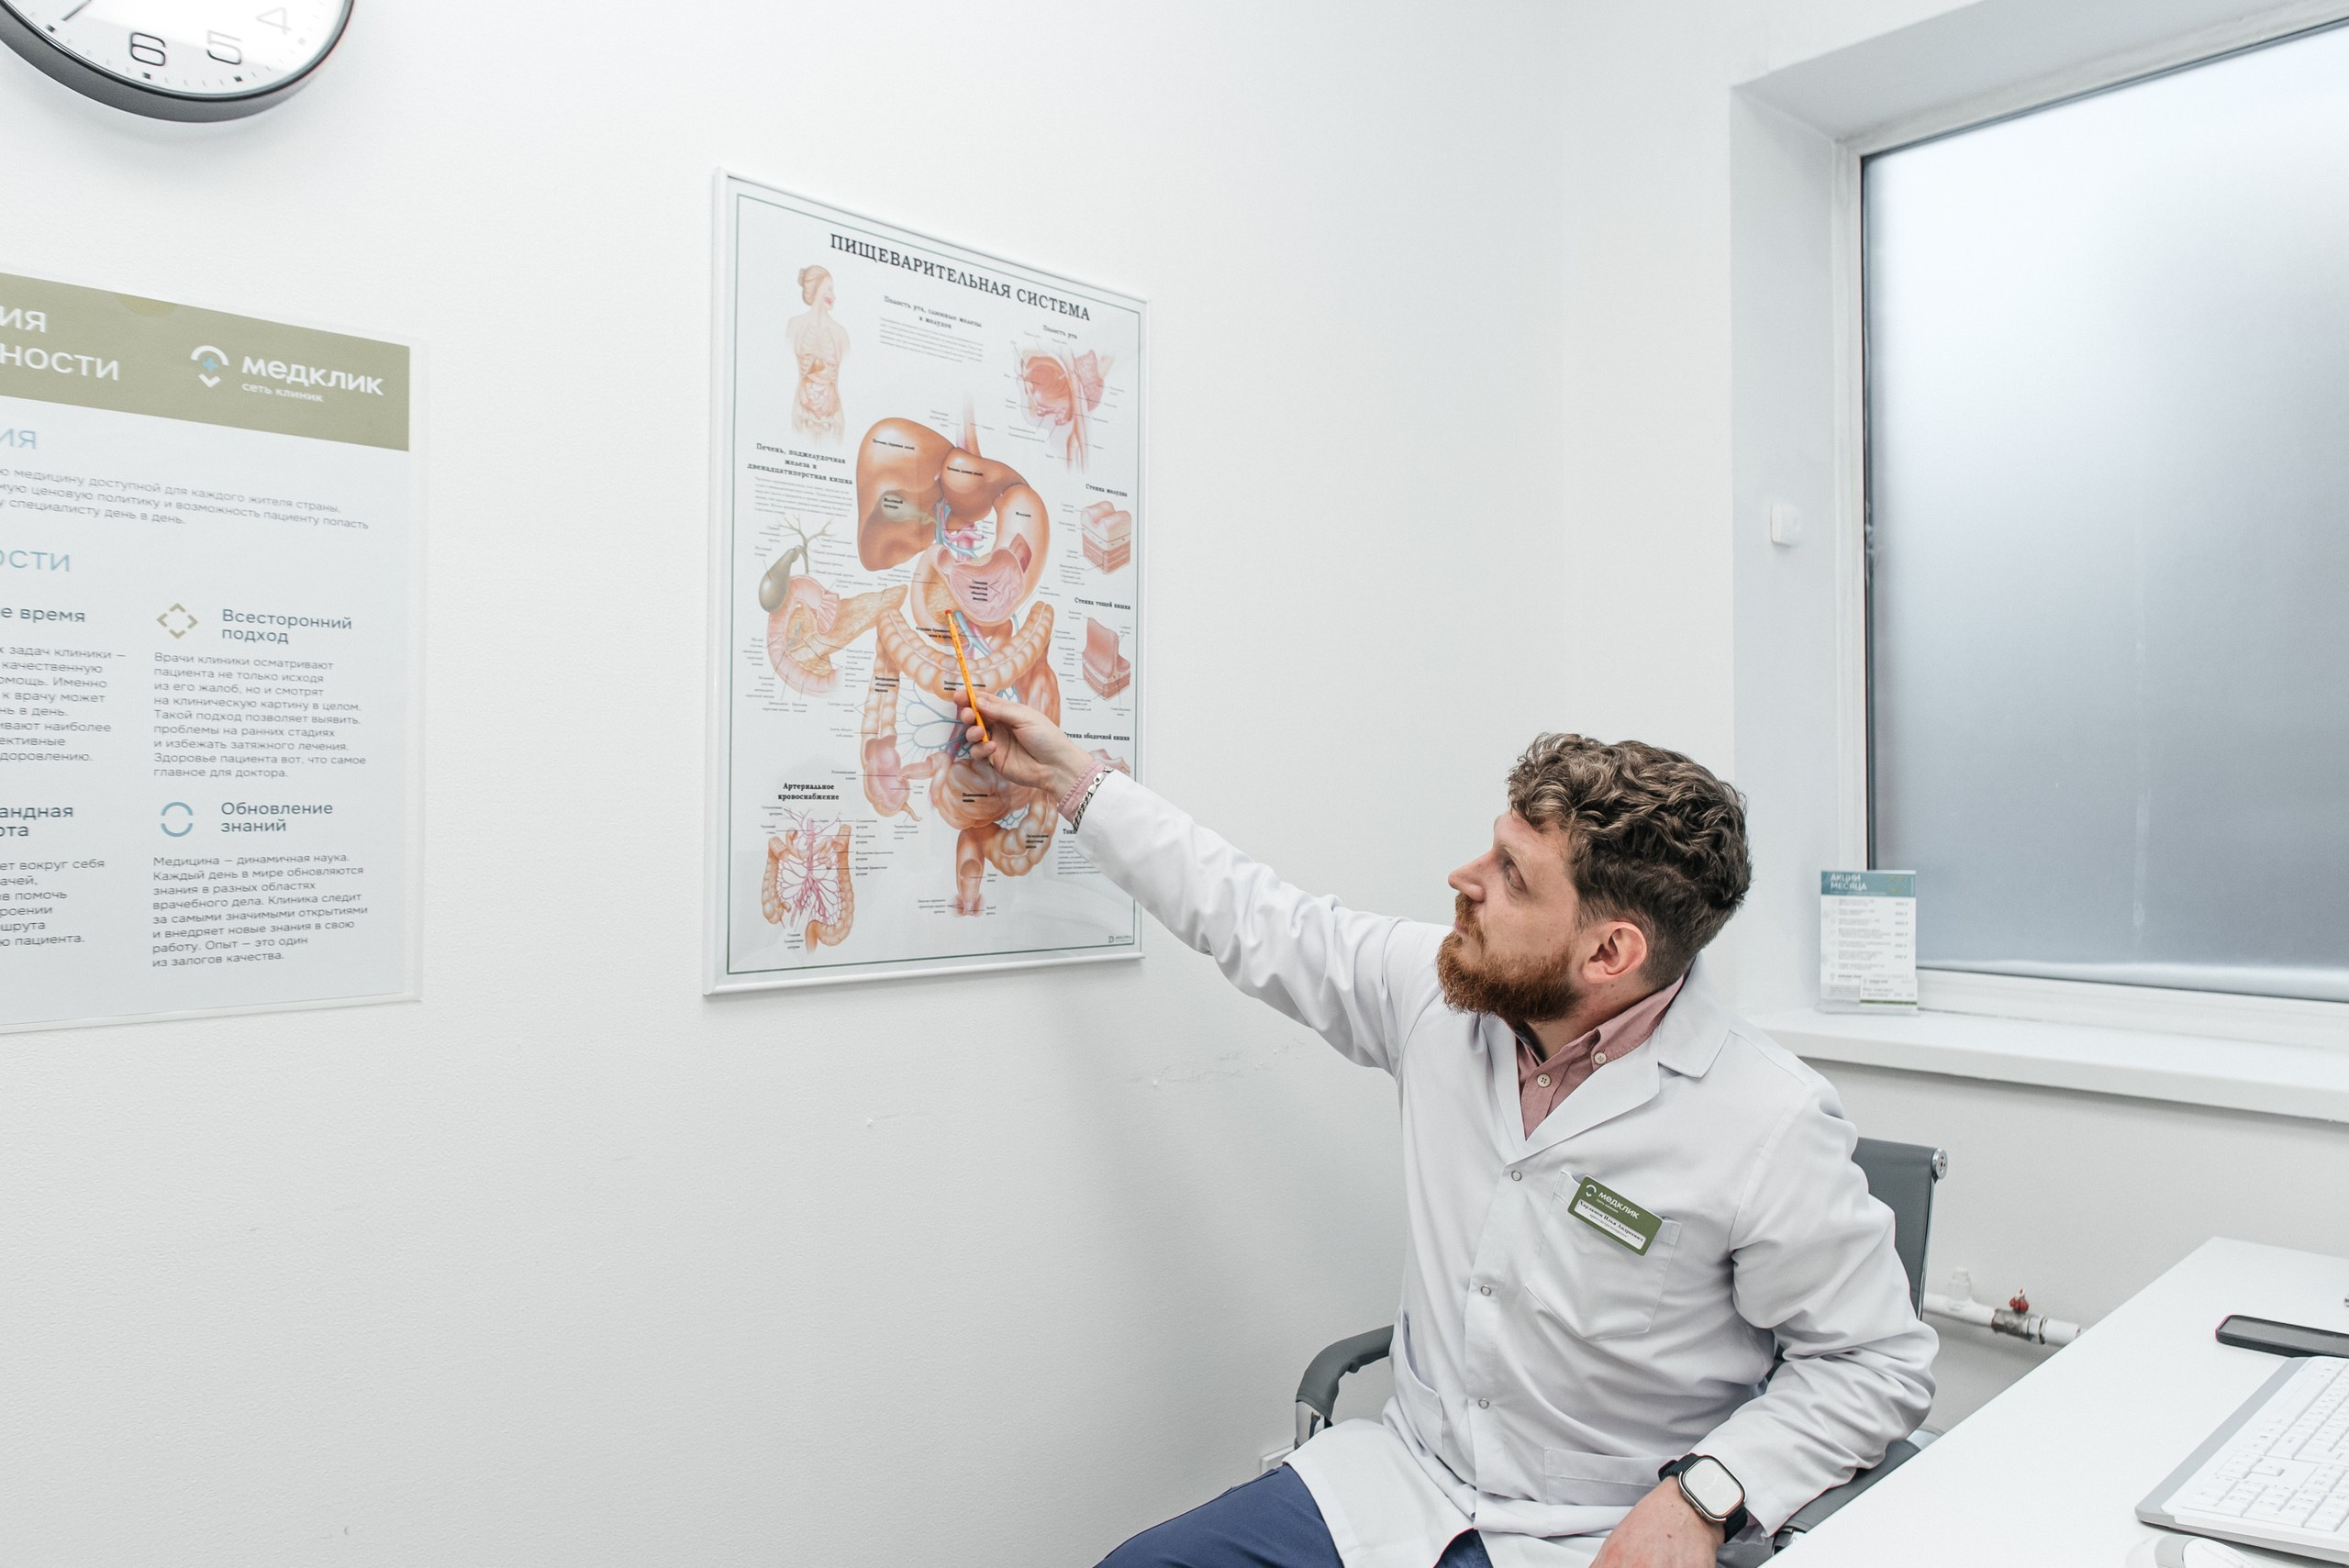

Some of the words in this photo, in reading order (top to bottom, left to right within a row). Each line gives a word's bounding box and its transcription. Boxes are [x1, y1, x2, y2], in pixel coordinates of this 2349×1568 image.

[130, 31, 166, 66] 6
[206, 29, 241, 65] 5
[829, 233, 1011, 299] ПИЩЕВАРИТЕЛЬНАЯ
[1017, 289, 1091, 321] СИСТЕМА
[0, 343, 119, 381] НОСТИ
[242, 356, 384, 395] медклик
[242, 383, 273, 395] сеть
[276, 388, 324, 402] клиник
[14, 470, 83, 485] медицину
[89, 478, 161, 493] доступной
[165, 486, 187, 495] для
[192, 489, 245, 503] каждого
[249, 495, 293, 506] жителя
[9, 499, 100, 517] специалисту
[105, 508, 137, 519] день
[151, 514, 185, 524] день.
[31, 487, 92, 501] ценовую
[97, 494, 160, 508] политику
[176, 502, 260, 518] возможность
[263, 512, 319, 526] пациенту
[323, 517, 369, 529] попасть
[0, 550, 70, 572] СТИ
[1, 607, 13, 617] е
[20, 608, 85, 623] время
[223, 609, 352, 629] Всесторонний
[222, 629, 289, 644] подход
[9, 646, 50, 657] задач
[54, 650, 112, 659] клиники
[2, 662, 103, 674] качественную
[154, 652, 194, 663] Врачи
[197, 656, 250, 666] клиники
[253, 658, 334, 670] осматривают
[53, 677, 107, 688] Именно
[154, 668, 214, 679] пациента
[218, 671, 233, 679] не
[237, 672, 279, 681] только
[282, 673, 324, 683] исходя
[154, 683, 170, 691] из
[173, 684, 195, 692] его
[275, 687, 324, 696] смотрят
[15, 693, 55, 704] врачу
[173, 698, 257, 709] клиническую
[261, 701, 308, 711] картину
[322, 703, 362, 712] целом.
[31, 708, 68, 717] день.
[154, 709, 193, 719] Такой
[196, 712, 242, 722] подход
[246, 713, 307, 723] позволяет
[45, 722, 111, 732] наиболее
[154, 726, 219, 736] проблемы
[241, 728, 284, 737] ранних
[288, 729, 335, 738] стадиях
[165, 740, 226, 749] избежать
[230, 741, 295, 751] затяжного
[297, 742, 349, 751] лечения.
[154, 753, 216, 763] Здоровье
[220, 755, 277, 764] пациента
[154, 768, 206, 777] главное
[209, 769, 231, 778] для
[235, 769, 288, 778] доктора.
[0, 807, 73, 820] андная
[221, 802, 334, 815] Обновление
[221, 818, 286, 832] знаний
[19, 861, 68, 872] вокруг
[72, 859, 105, 868] себя
[153, 856, 219, 867] Медицина
[237, 853, 310, 865] динамичная
[314, 853, 350, 863] наука.
[153, 871, 205, 882] Каждый
[208, 871, 238, 880] день
[252, 869, 284, 879] мире
[287, 866, 363, 877] обновляются
[153, 885, 198, 895] знания
[213, 884, 257, 895] разных
[262, 882, 316, 892] областях
[15, 892, 67, 900] помочь
[153, 898, 228, 911] врачебного
[232, 897, 264, 907] дела.
[268, 895, 318, 905] Клиника
[322, 894, 362, 903] следит
[0, 906, 52, 917] роении
[153, 916, 167, 925] за
[172, 914, 221, 923] самыми
[226, 910, 295, 921] значимыми
[298, 906, 368, 917] открытиями
[1, 922, 46, 932] шрута
[165, 927, 224, 939] внедряет
[228, 926, 266, 934] новые
[270, 923, 311, 932] знания
[325, 921, 354, 929] свою
[15, 935, 85, 947] пациента.
[153, 943, 201, 954] работу.
[206, 940, 238, 951] Опыт
[255, 939, 274, 947] это
[279, 937, 308, 946] один
[153, 959, 167, 967] из
[172, 955, 222, 966] залогов
[227, 951, 284, 962] качества.
